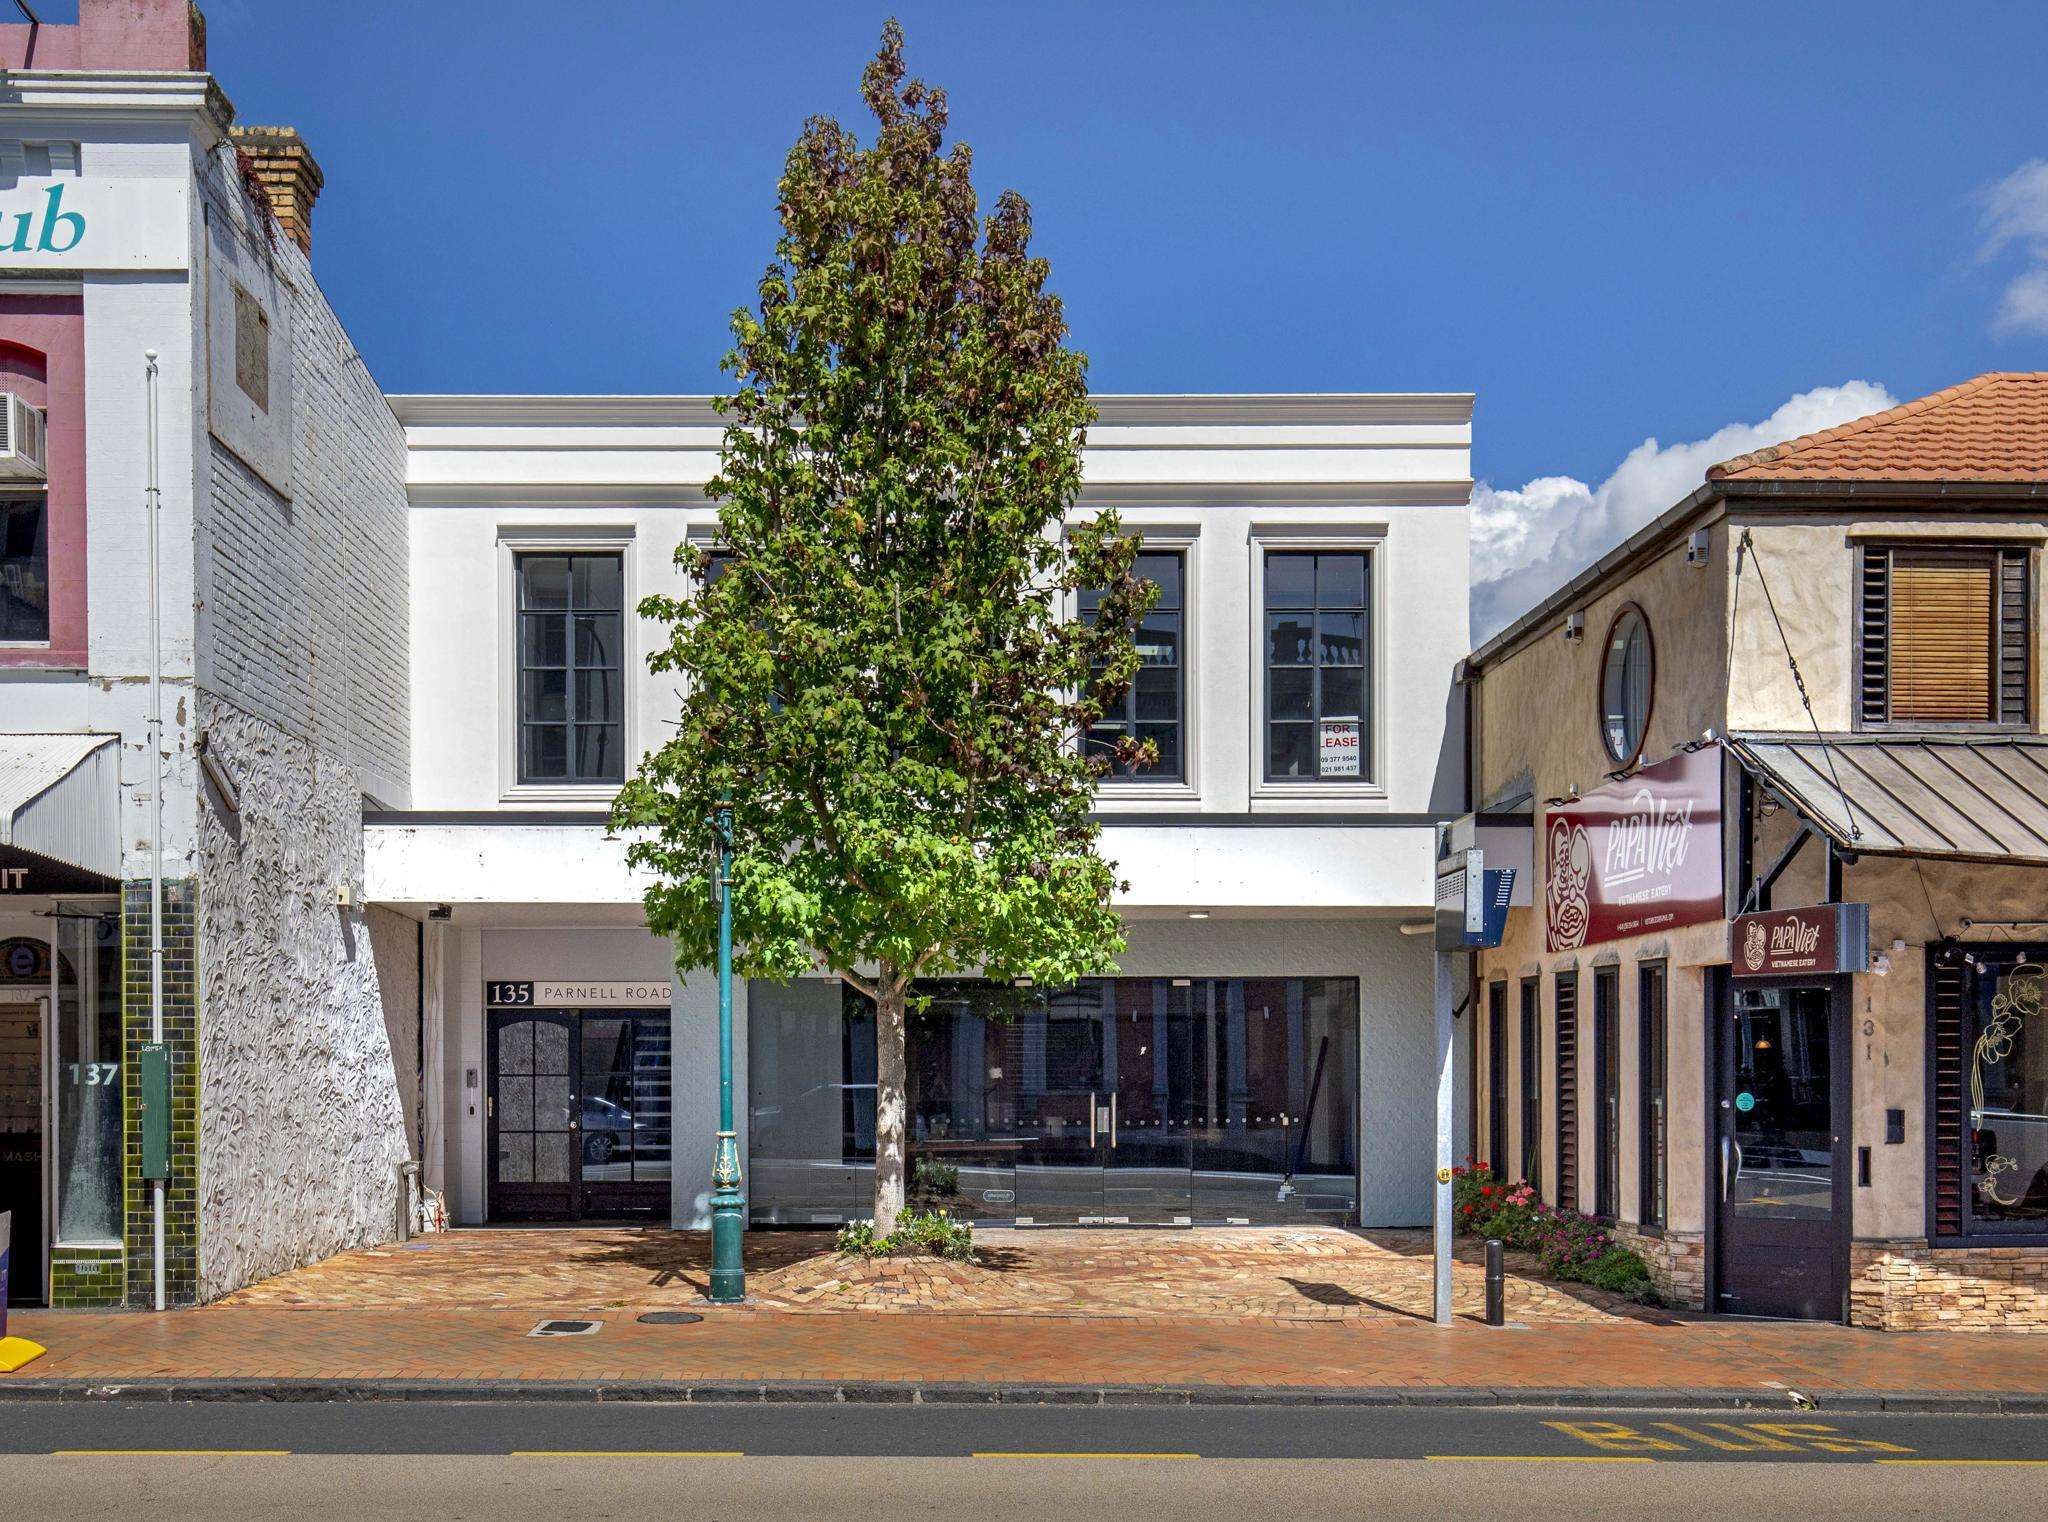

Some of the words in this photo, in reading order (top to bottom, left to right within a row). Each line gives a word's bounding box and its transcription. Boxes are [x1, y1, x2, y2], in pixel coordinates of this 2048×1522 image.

[0, 183, 86, 253] ub
[1325, 724, 1350, 734] FOR
[1321, 737, 1358, 748] EASE
[1605, 813, 1648, 874] PAPA
[1770, 926, 1795, 949] PAPA
[492, 983, 529, 1003] 135
[544, 986, 617, 999] PARNELL
[625, 986, 672, 999] ROAD
[69, 1063, 118, 1086] 137
[1538, 1420, 1918, 1452] BUS
